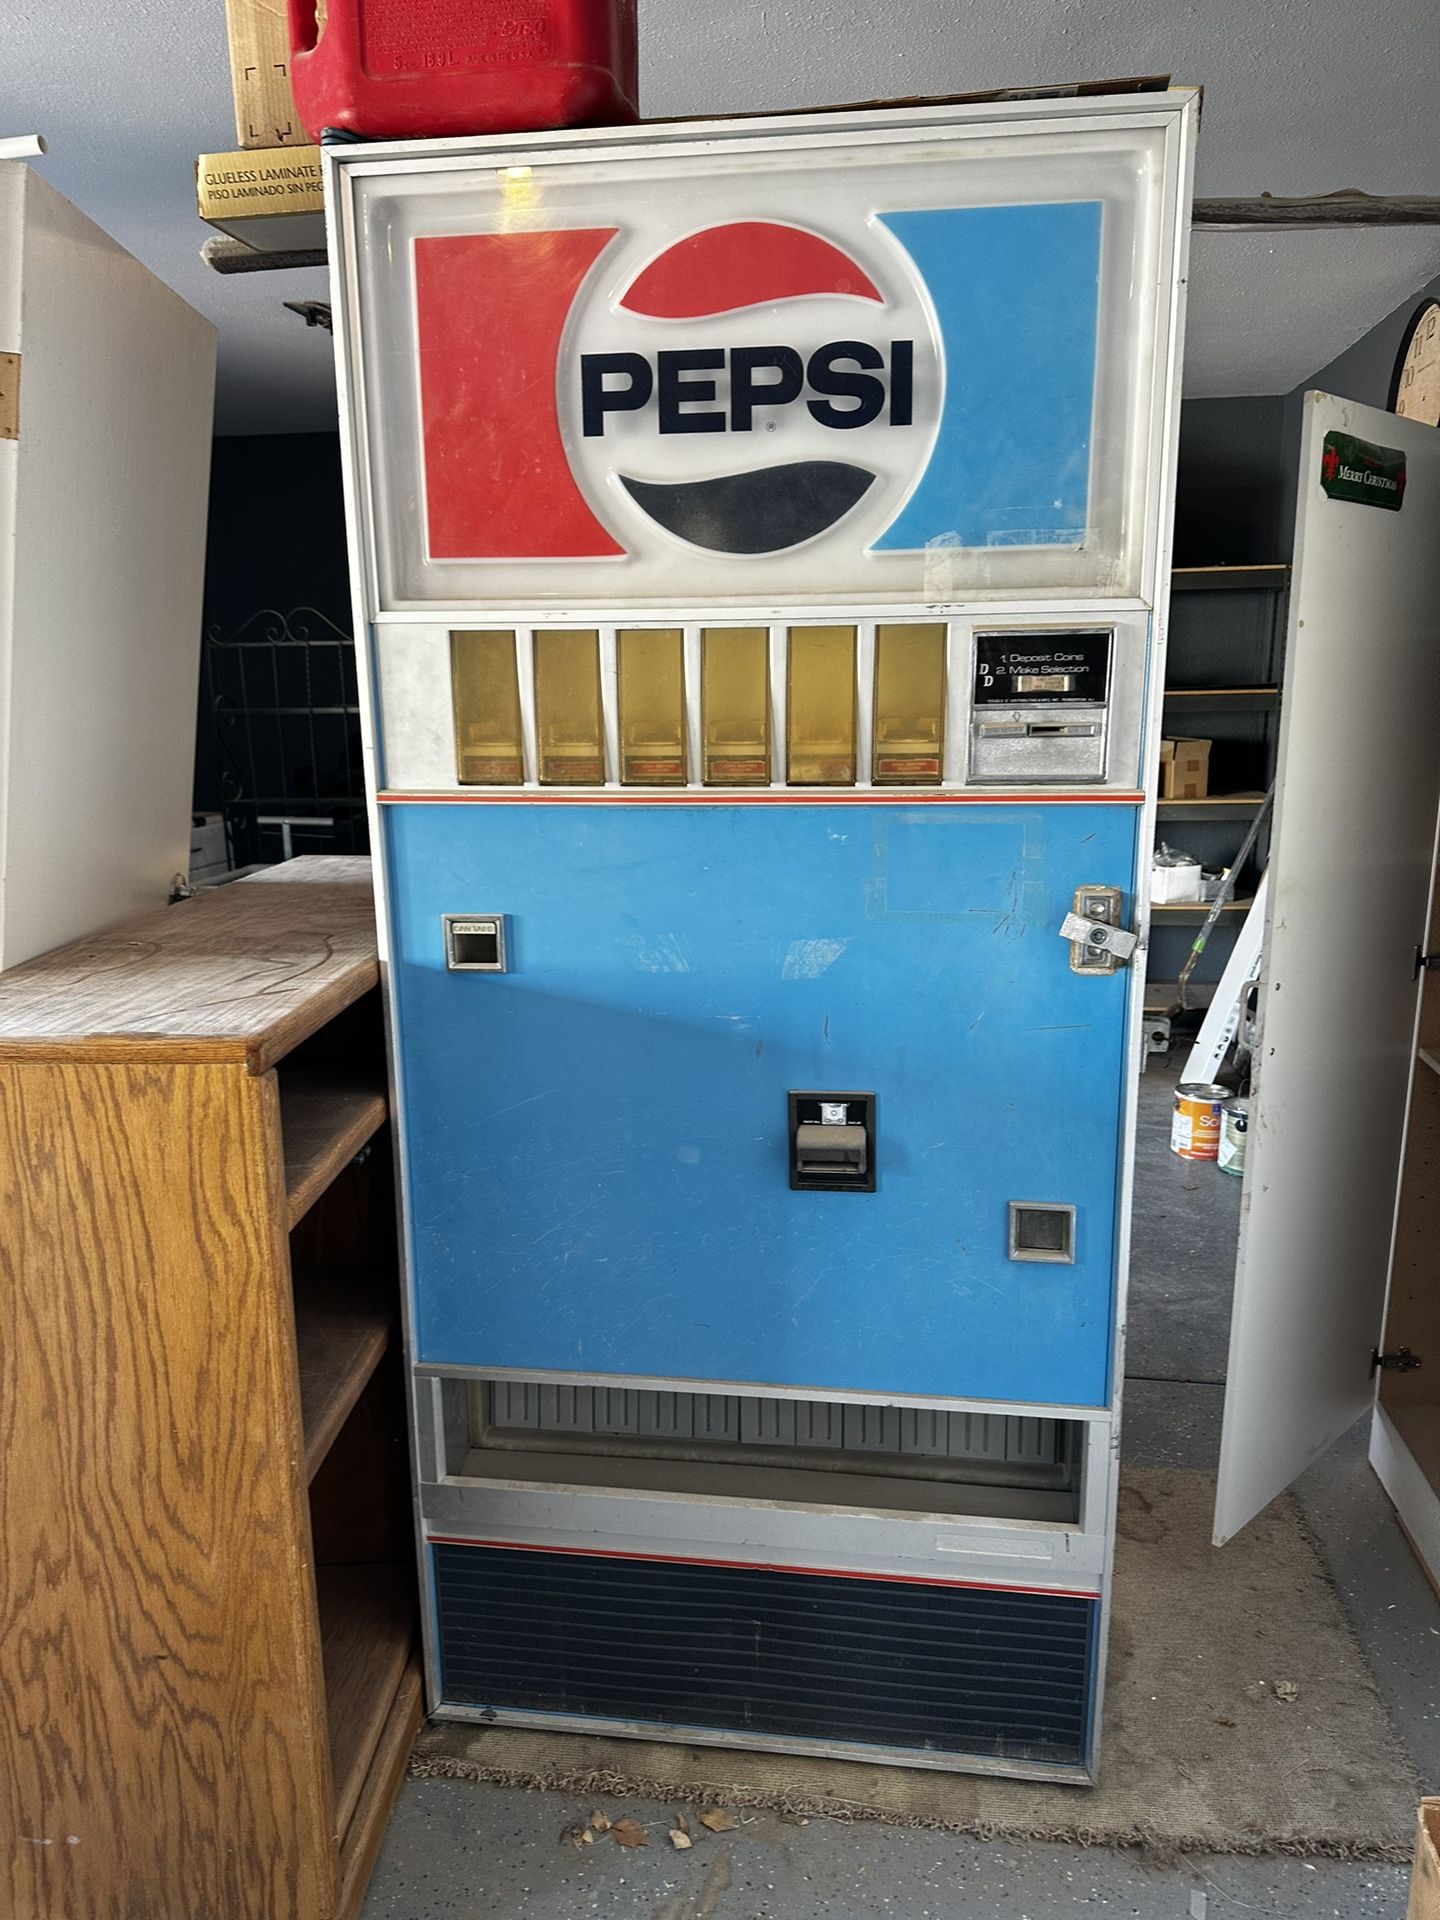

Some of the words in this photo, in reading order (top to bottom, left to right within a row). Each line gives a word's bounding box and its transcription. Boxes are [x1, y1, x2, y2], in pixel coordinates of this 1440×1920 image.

[205, 170, 257, 185] GLUELESS
[258, 165, 317, 181] LAMINATE
[208, 189, 230, 200] PISO
[231, 184, 285, 198] LAMINADO
[287, 183, 305, 194] SIN
[581, 340, 914, 437] PEPSI
[1009, 653, 1052, 663] Deposit
[1054, 652, 1085, 662] Coins
[979, 663, 989, 675] D
[1008, 666, 1040, 675] Make
[1040, 665, 1090, 675] Selection
[983, 675, 994, 687] D
